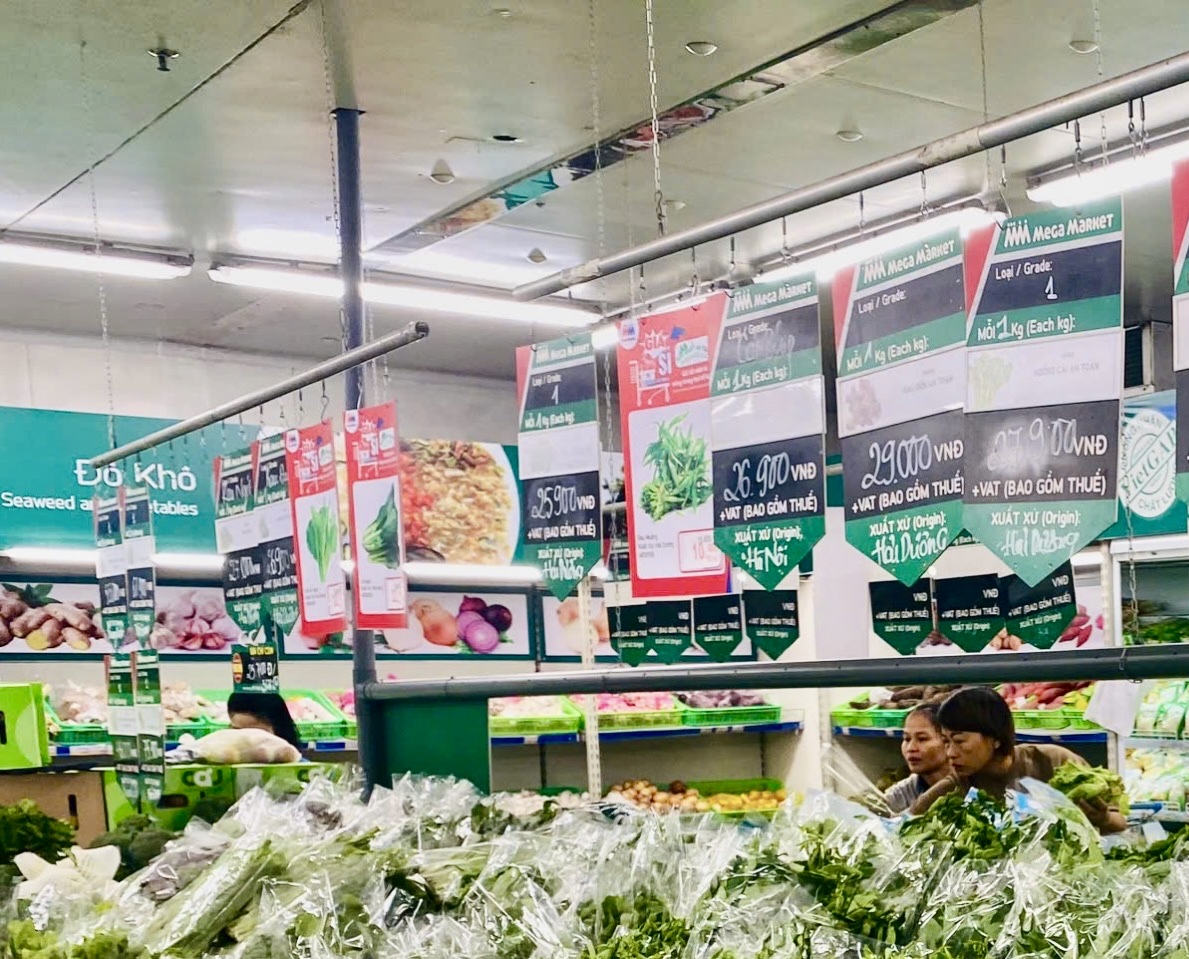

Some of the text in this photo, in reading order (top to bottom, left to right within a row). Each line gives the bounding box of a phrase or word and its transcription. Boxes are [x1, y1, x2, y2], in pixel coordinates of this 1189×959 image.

[996, 261, 1052, 281] Loại Grade:
[934, 439, 963, 462] VNĐ
[134, 463, 196, 491] Khô
[791, 462, 816, 481] VNĐ
[852, 470, 964, 514] +VAT (BAO GỒM THUẾ)
[972, 468, 1107, 499] +VAT (BAO GỒM THUẾ)
[1, 492, 75, 510] Seaweed
[577, 495, 595, 510] VNĐ
